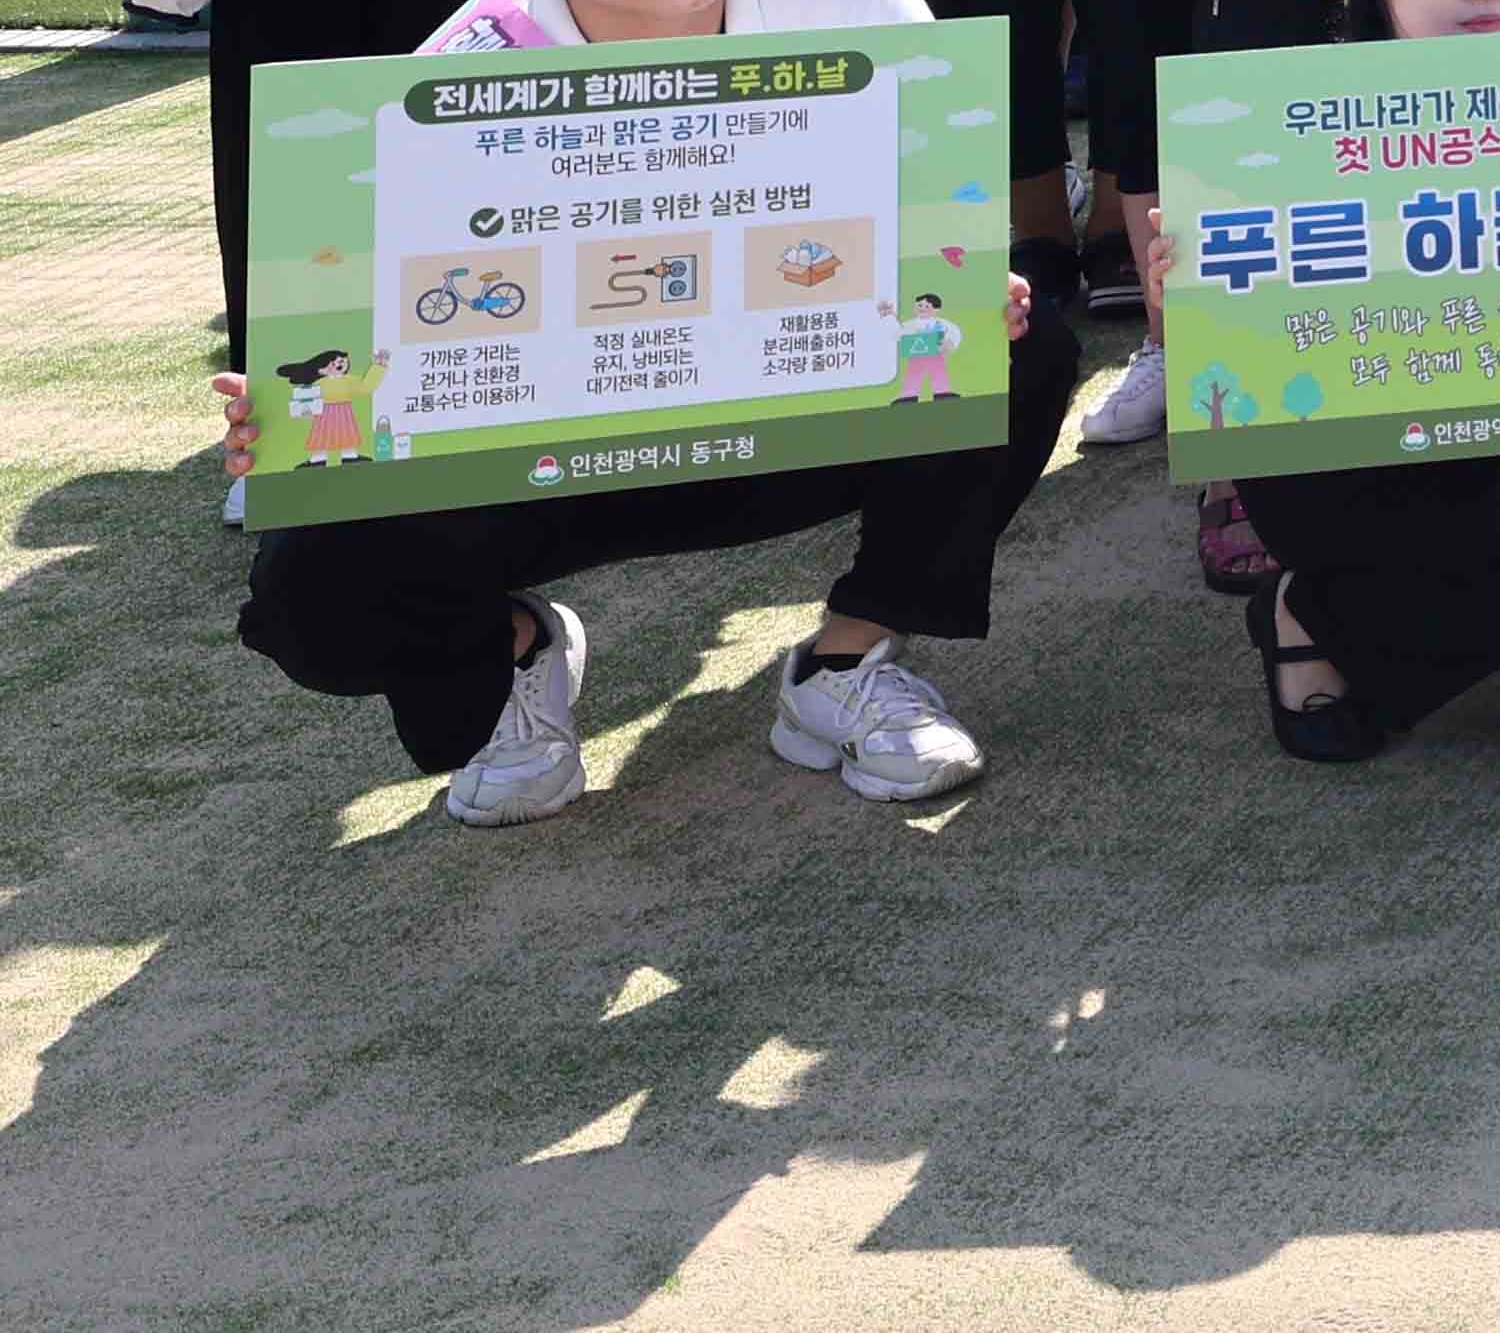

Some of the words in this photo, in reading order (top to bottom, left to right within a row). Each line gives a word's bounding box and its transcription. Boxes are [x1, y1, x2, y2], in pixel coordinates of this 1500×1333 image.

[432, 75, 574, 119] 전세계가
[584, 65, 719, 108] 함께하는
[728, 55, 848, 97] 푸.하.날
[1283, 88, 1456, 138] 우리나라가
[1334, 136, 1371, 176] 첫
[1194, 197, 1372, 296] 푸른
[779, 311, 839, 334] 재활용품
[1284, 309, 1338, 353] 맑은
[1350, 302, 1427, 343] 공기와
[1440, 297, 1484, 337] 푸른
[593, 332, 625, 353] 적정
[629, 325, 693, 349] 실내온도
[763, 330, 854, 357] 분리배출하여
[419, 347, 468, 370] 가까운
[472, 342, 520, 365] 거리는
[592, 352, 627, 375] 유지,
[632, 346, 693, 370] 낭비되는
[762, 355, 807, 378] 소각량
[812, 351, 854, 373] 줄이기
[1349, 354, 1390, 387] 모두
[1404, 347, 1462, 385] 함께
[419, 368, 467, 392] 걷거나
[471, 363, 520, 387] 친환경
[586, 372, 648, 397] 대기전력
[652, 367, 699, 390] 줄이기
[403, 390, 468, 416] 교통수단
[471, 383, 536, 409] 이용하기
[569, 442, 682, 481] 인천광역시
[690, 434, 755, 467] 동구청
